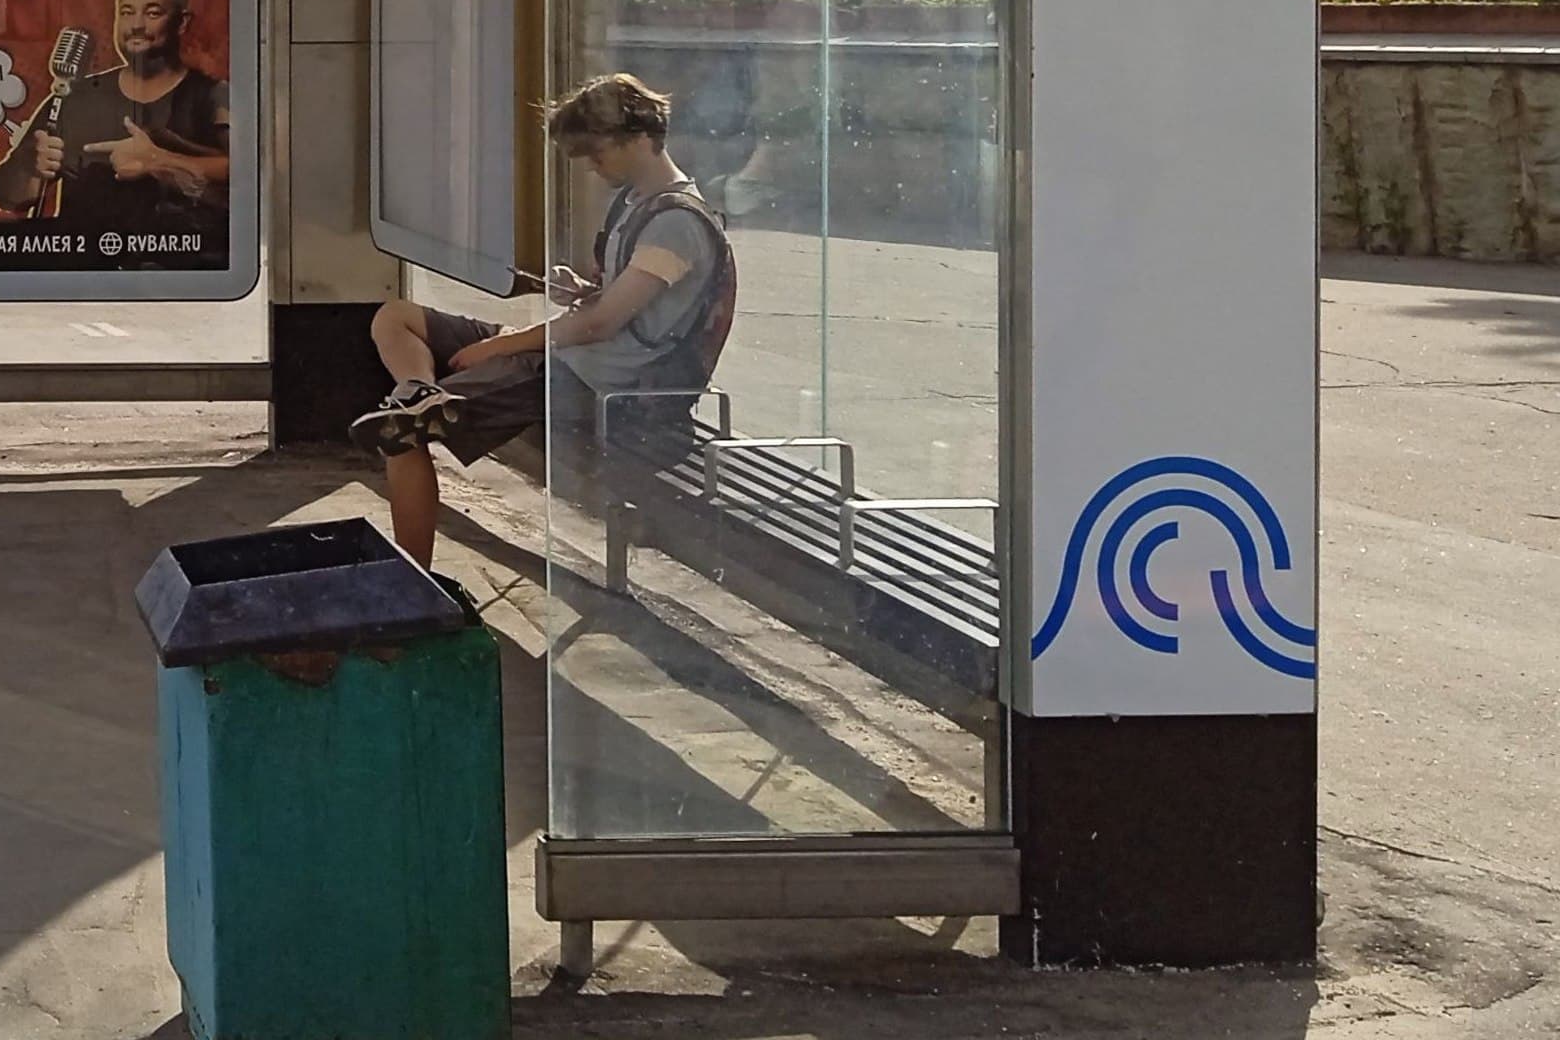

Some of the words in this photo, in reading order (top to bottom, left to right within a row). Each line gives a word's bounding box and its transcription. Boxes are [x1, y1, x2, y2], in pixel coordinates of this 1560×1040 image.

[22, 235, 72, 254] АЛЛЕЯ
[76, 235, 86, 253] 2
[127, 234, 201, 253] RVBAR.RU
